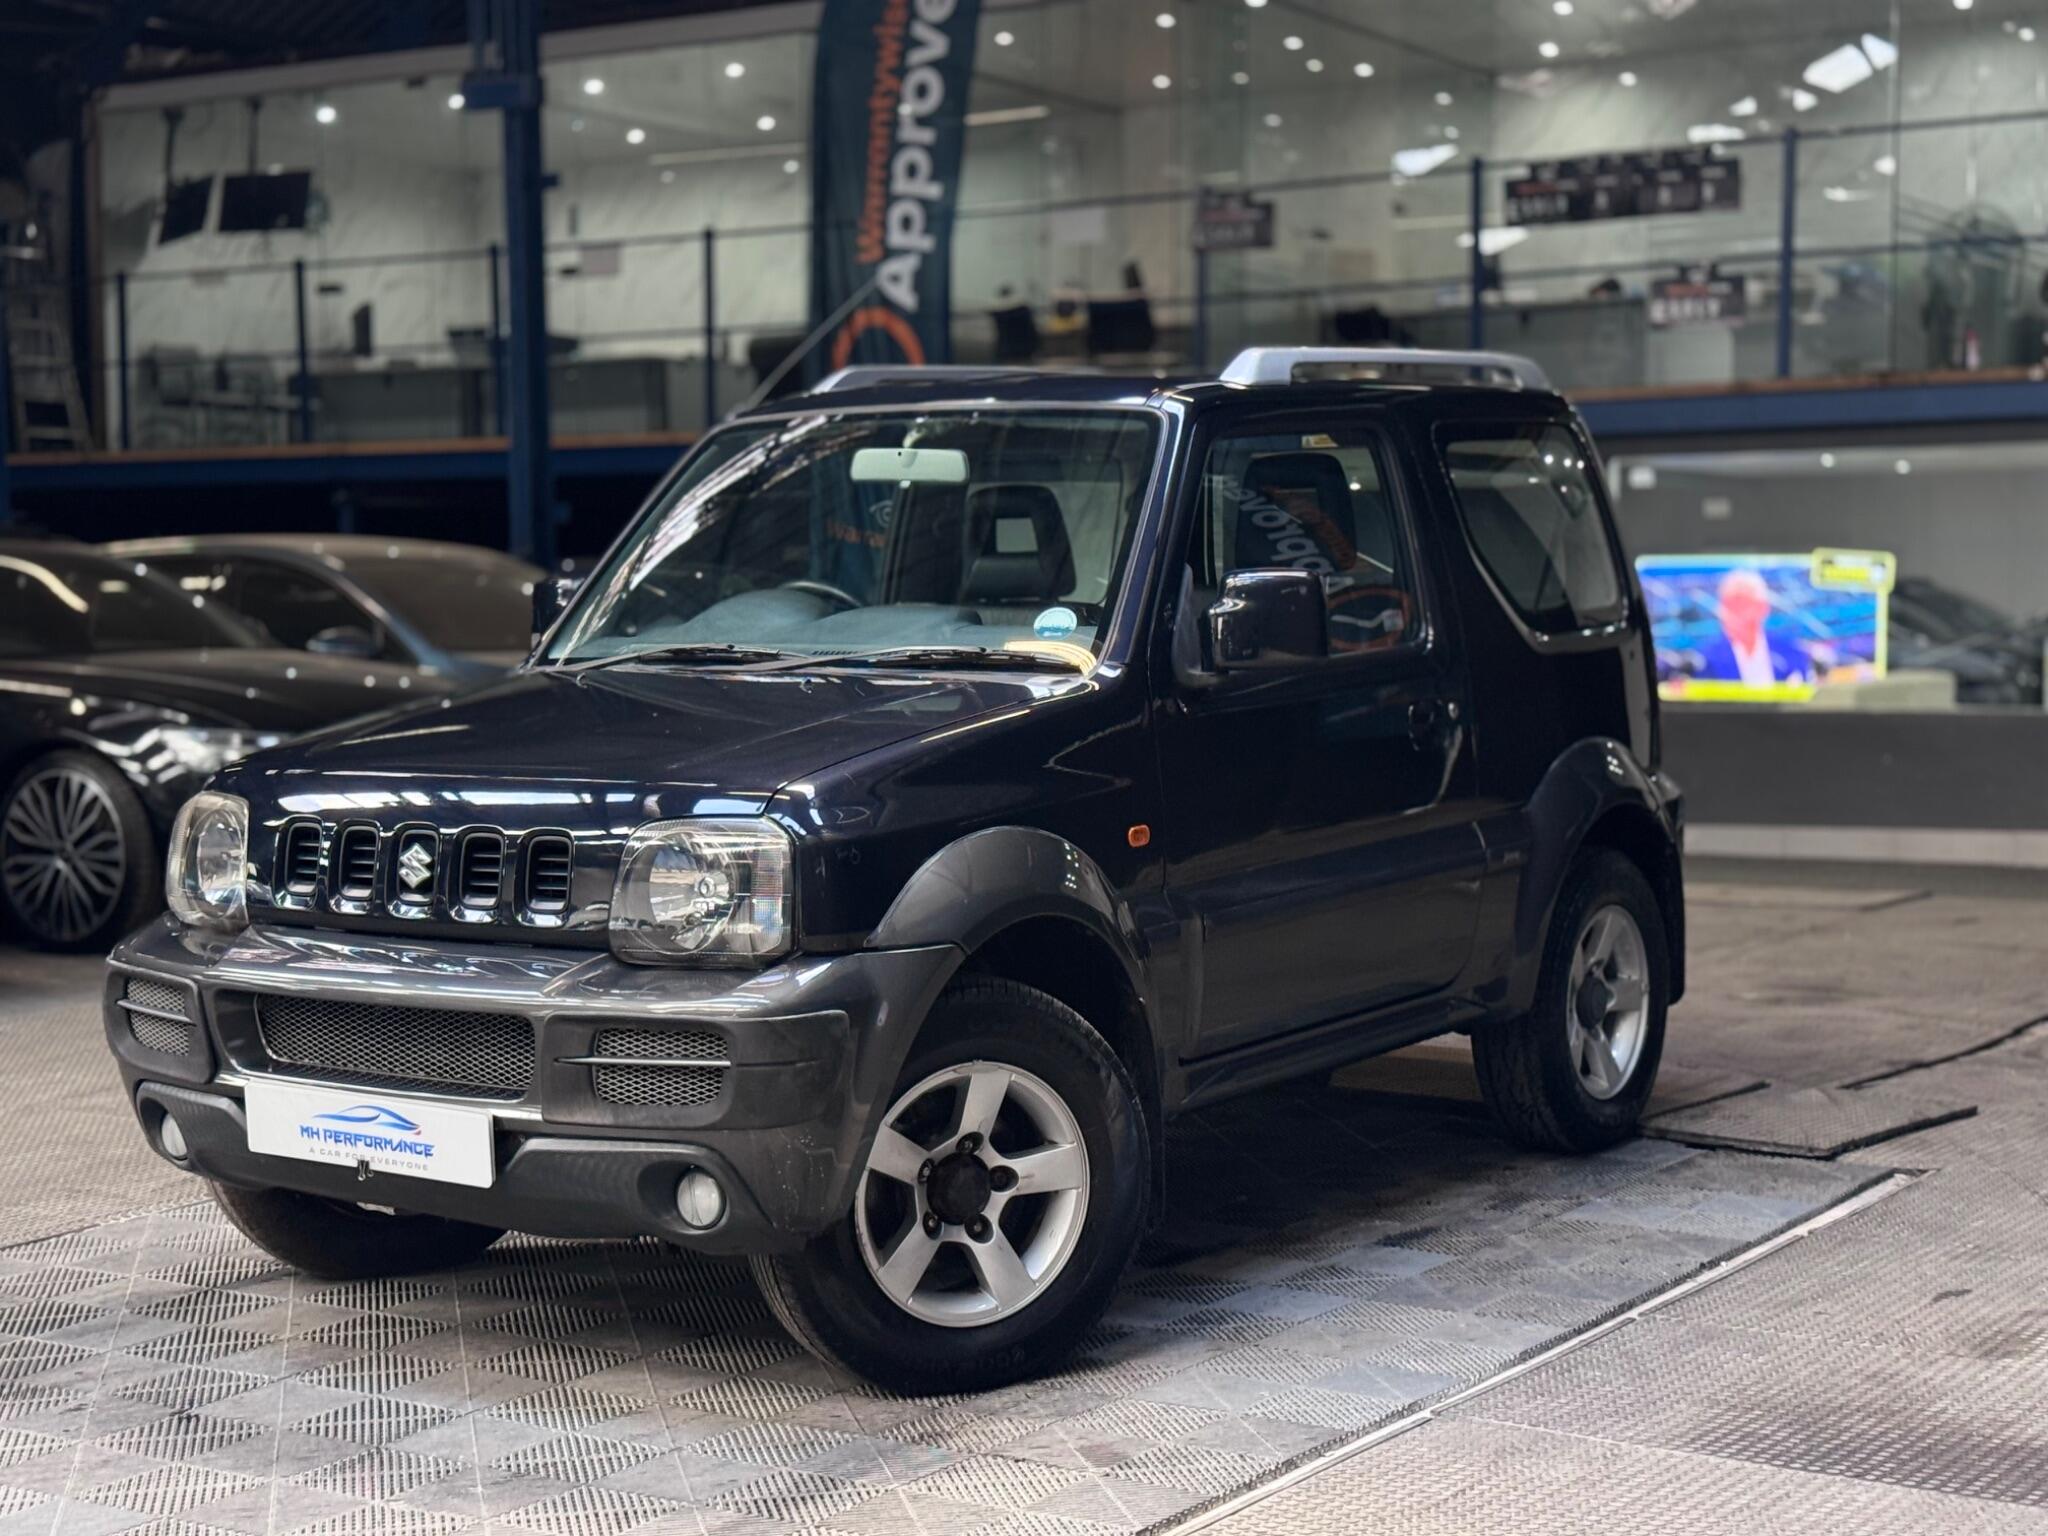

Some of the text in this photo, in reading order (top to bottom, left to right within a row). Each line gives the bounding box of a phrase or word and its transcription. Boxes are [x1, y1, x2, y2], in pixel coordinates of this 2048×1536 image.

[299, 1124, 435, 1158] MH PERFORMANCE
[319, 1149, 341, 1159] CAR
[345, 1152, 366, 1161] FOR
[370, 1156, 429, 1171] EVERYONE
